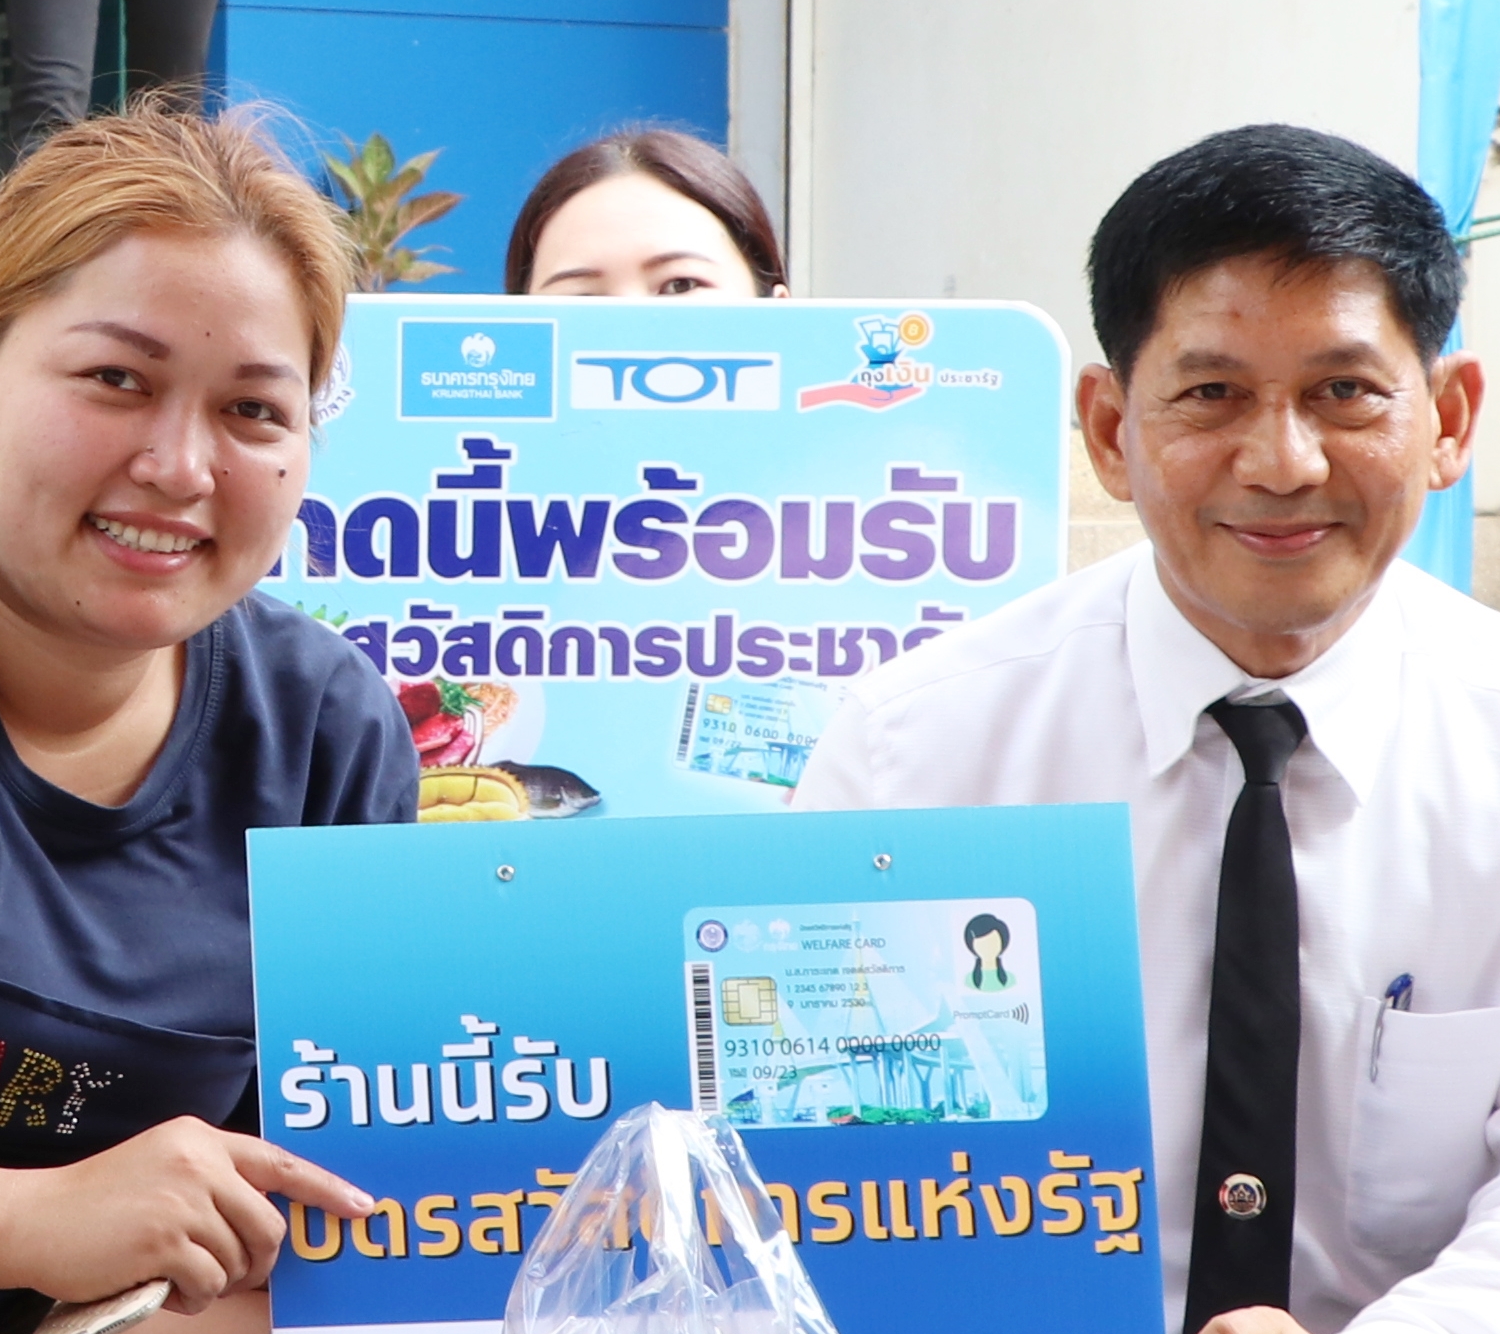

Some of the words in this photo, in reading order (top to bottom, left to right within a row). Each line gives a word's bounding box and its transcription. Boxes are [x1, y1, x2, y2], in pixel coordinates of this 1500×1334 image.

[420, 368, 536, 389] ธนาคารกรุงไทย
[576, 356, 775, 404] TOT
[860, 361, 931, 388] ถุงเงิน
[940, 372, 999, 387] ประชารัฐ
[431, 389, 493, 399] KRUNGTHAI
[494, 389, 524, 399] BANK
[263, 437, 1018, 581] าดนี้พร้อมรับ
[703, 717, 738, 733] 9310
[801, 937, 852, 951] WELFARE
[854, 937, 886, 950] CARD
[953, 1010, 1011, 1023] PromptCard
[724, 1038, 774, 1057] 9310
[781, 1037, 829, 1055] 0614
[835, 1035, 886, 1054] 0000
[891, 1033, 941, 1053] 0000
[279, 1012, 611, 1131] ร้านนี้รับ
[752, 1064, 798, 1080] 09/23
